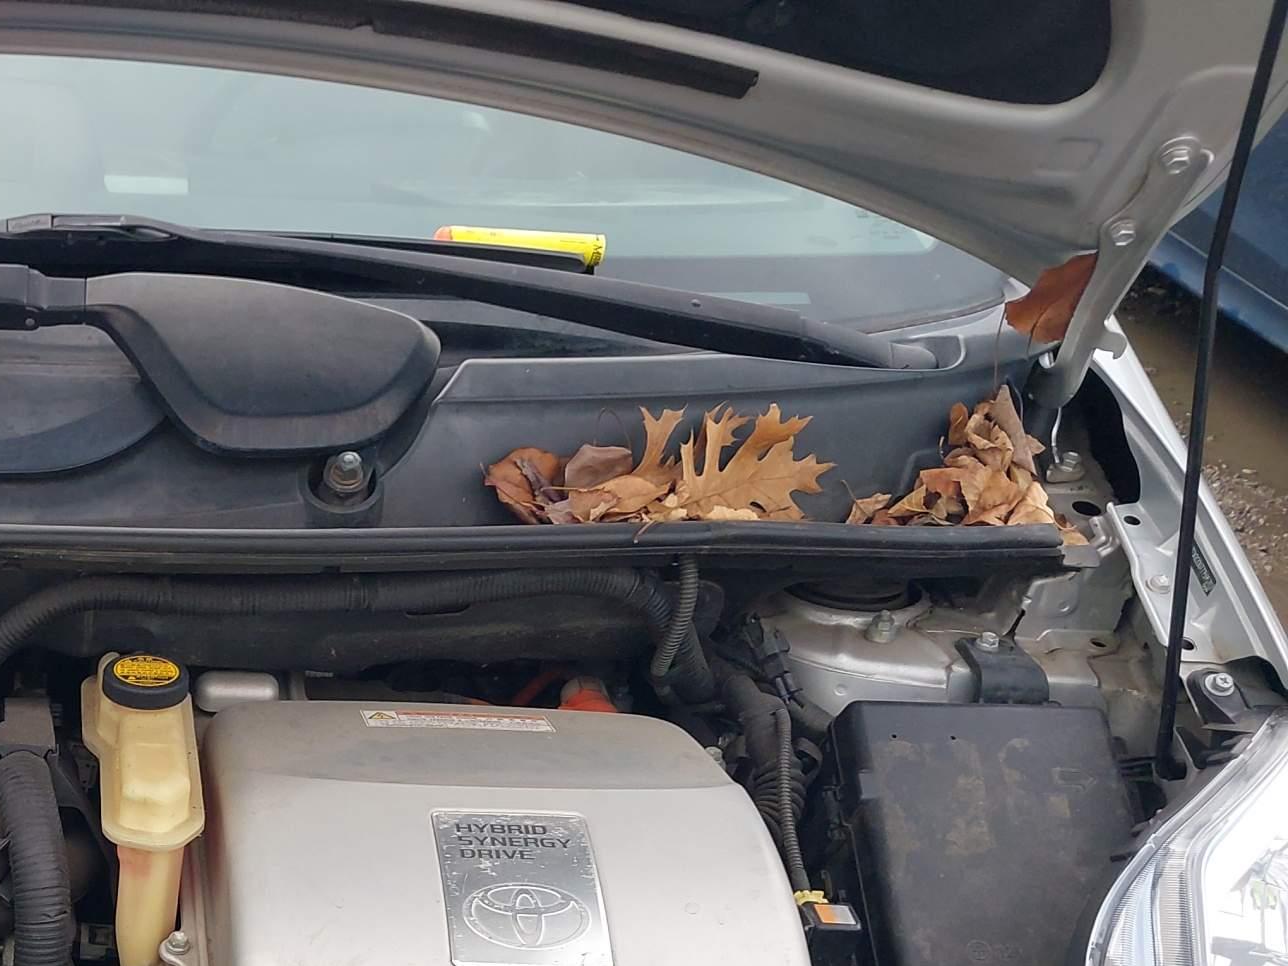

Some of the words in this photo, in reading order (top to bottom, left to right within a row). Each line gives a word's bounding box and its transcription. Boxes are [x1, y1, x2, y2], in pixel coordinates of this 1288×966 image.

[455, 823, 548, 835] HYBRID
[457, 835, 571, 848] SYNERGY
[459, 848, 536, 860] DRIVE
